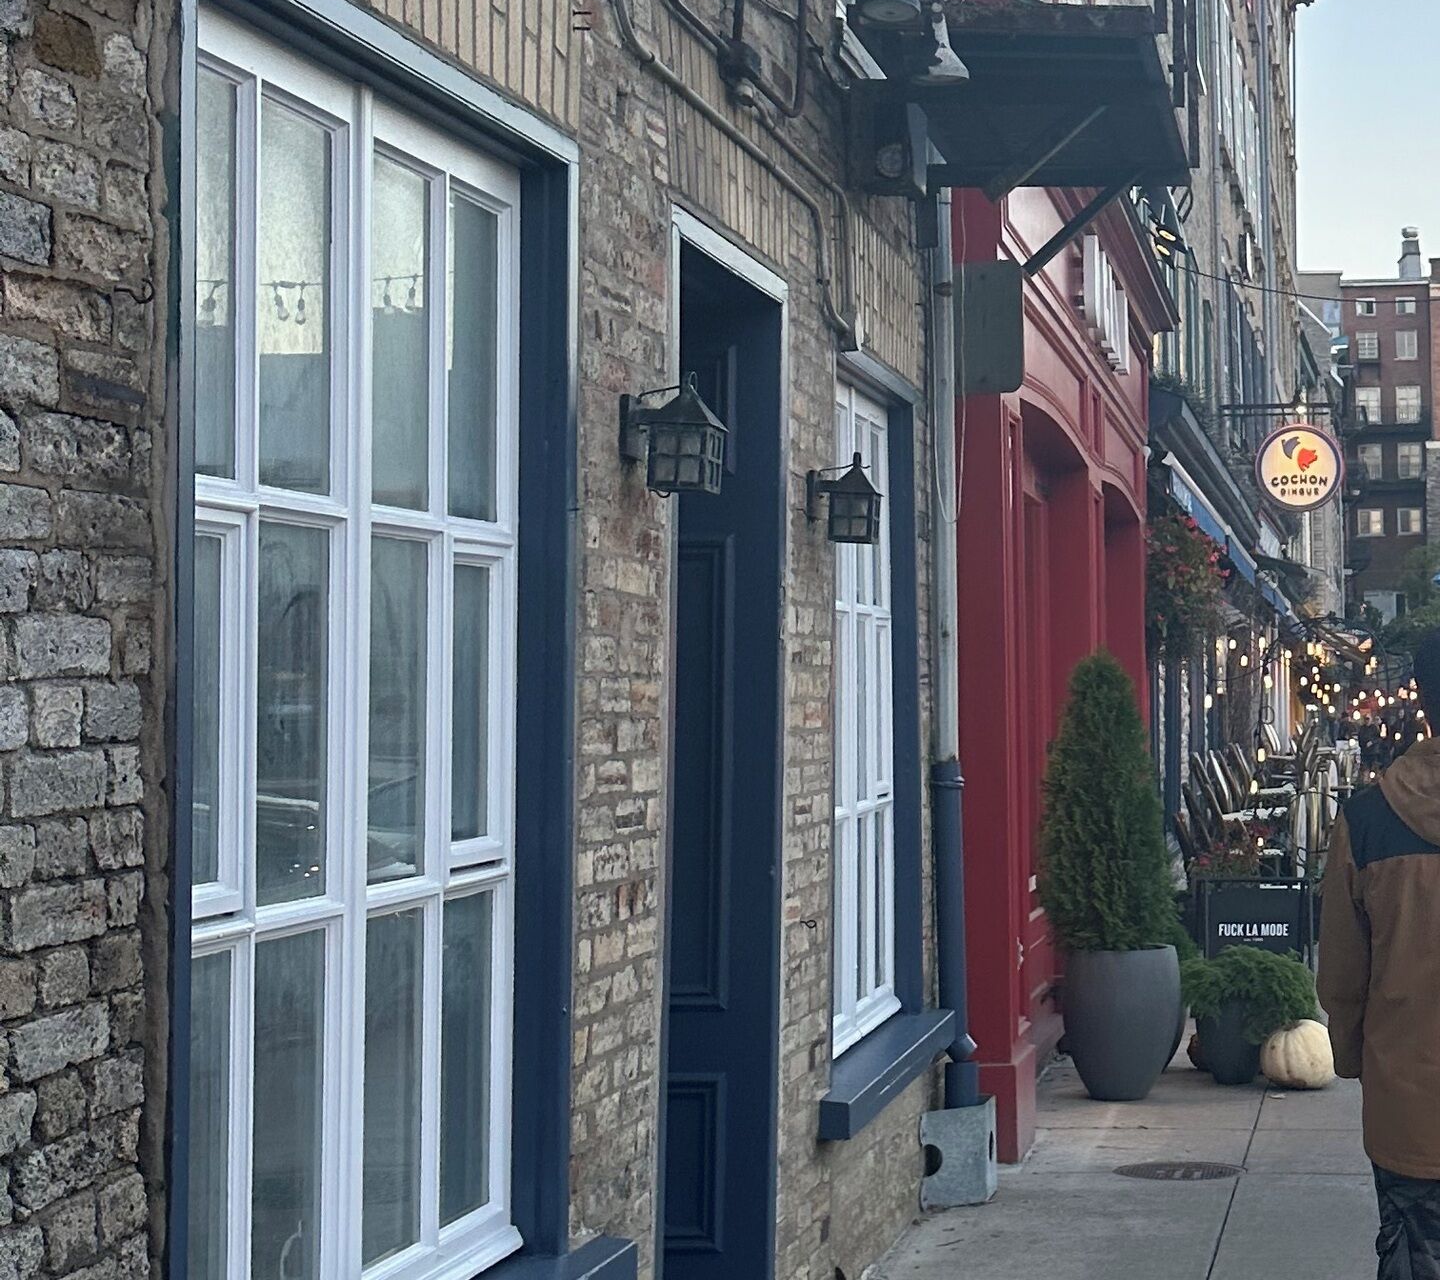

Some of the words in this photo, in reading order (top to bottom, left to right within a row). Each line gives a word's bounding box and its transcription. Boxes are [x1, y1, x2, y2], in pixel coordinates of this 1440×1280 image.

[1271, 474, 1328, 487] COCHON
[1218, 923, 1244, 936] FUCK
[1246, 923, 1259, 936] LA
[1260, 923, 1289, 936] MODE
